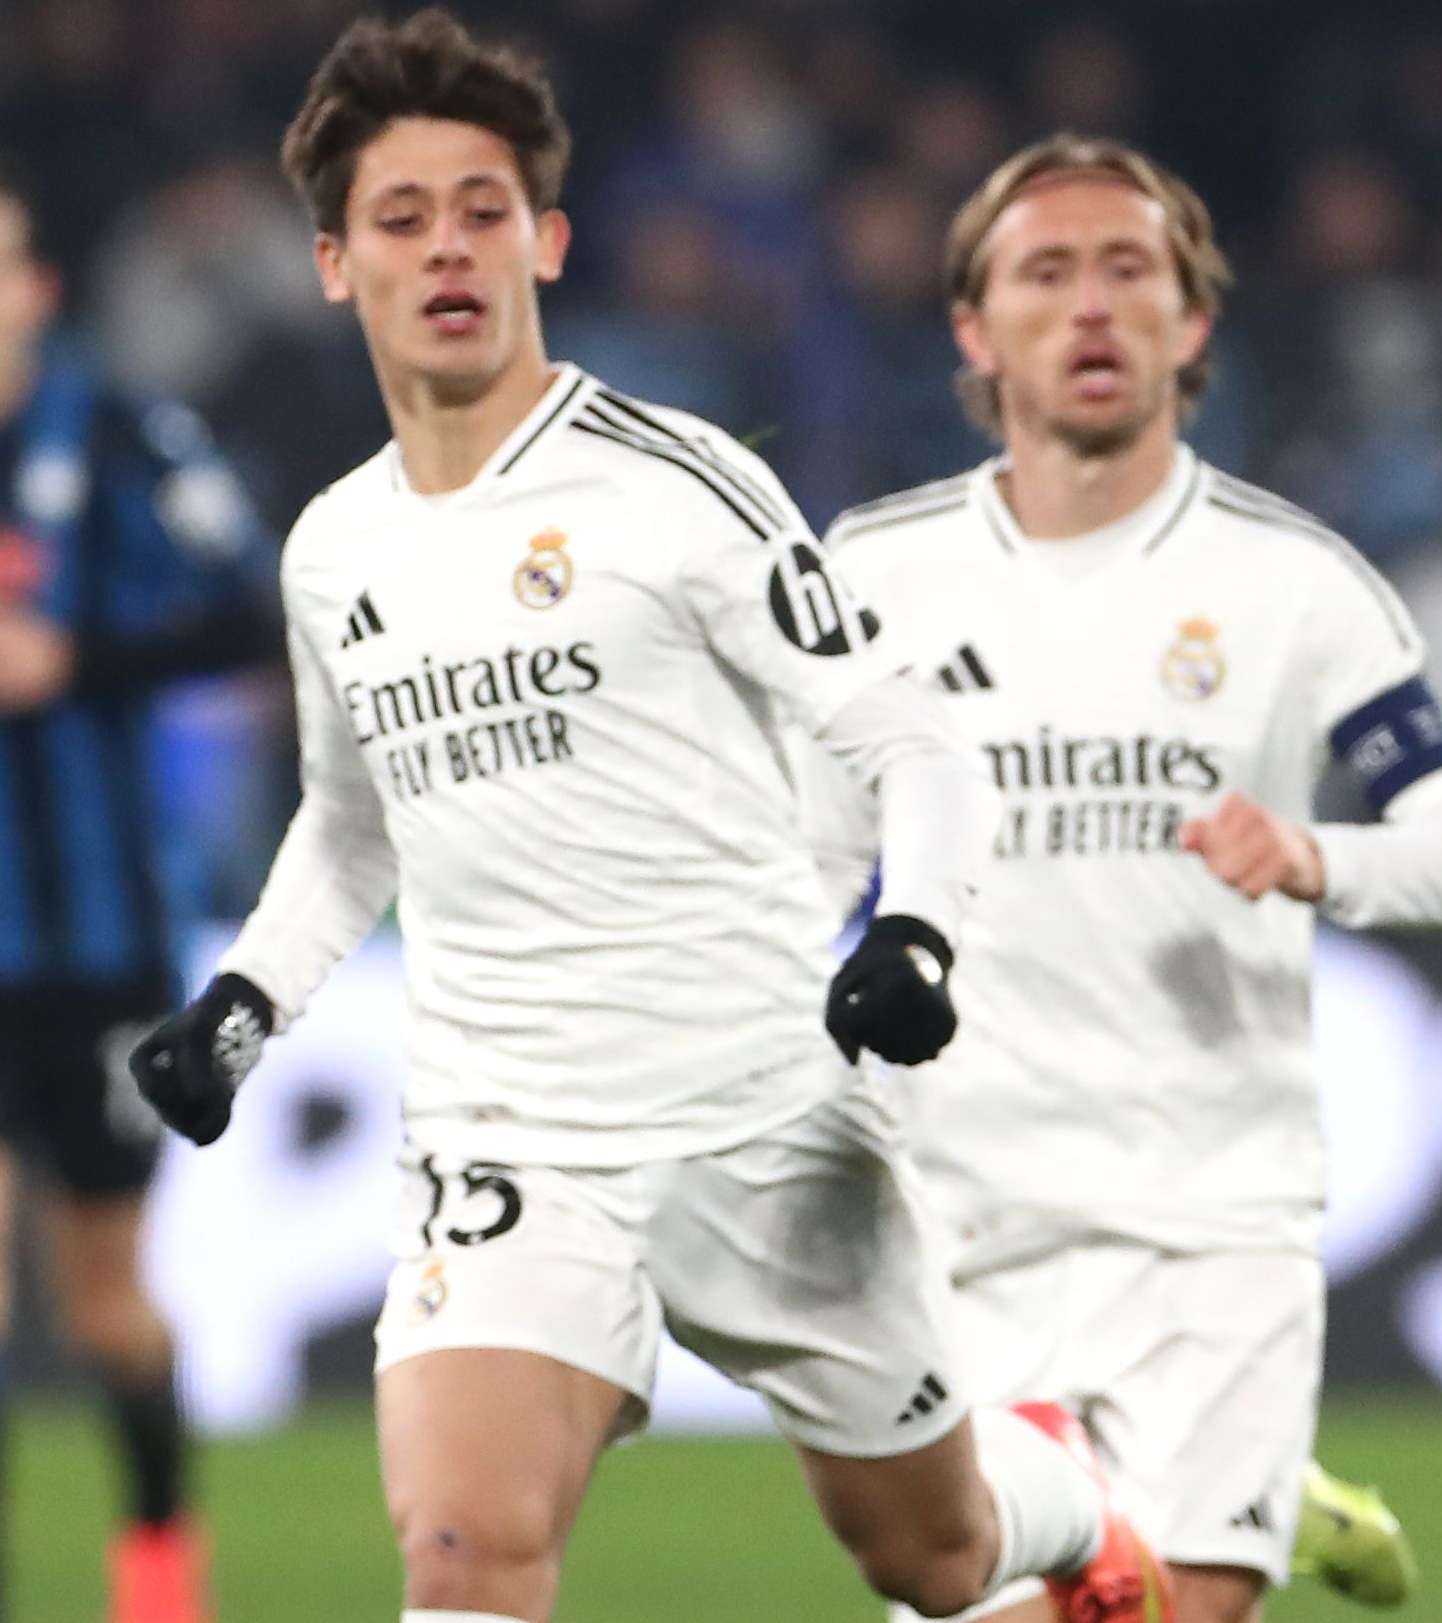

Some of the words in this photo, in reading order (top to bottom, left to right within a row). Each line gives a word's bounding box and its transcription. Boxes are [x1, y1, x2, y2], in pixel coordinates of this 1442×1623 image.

[344, 641, 602, 747] Emirates
[387, 740, 434, 800] FLY
[444, 708, 573, 783] BETTER
[980, 724, 1221, 795] mirates
[420, 1153, 522, 1246] 15
